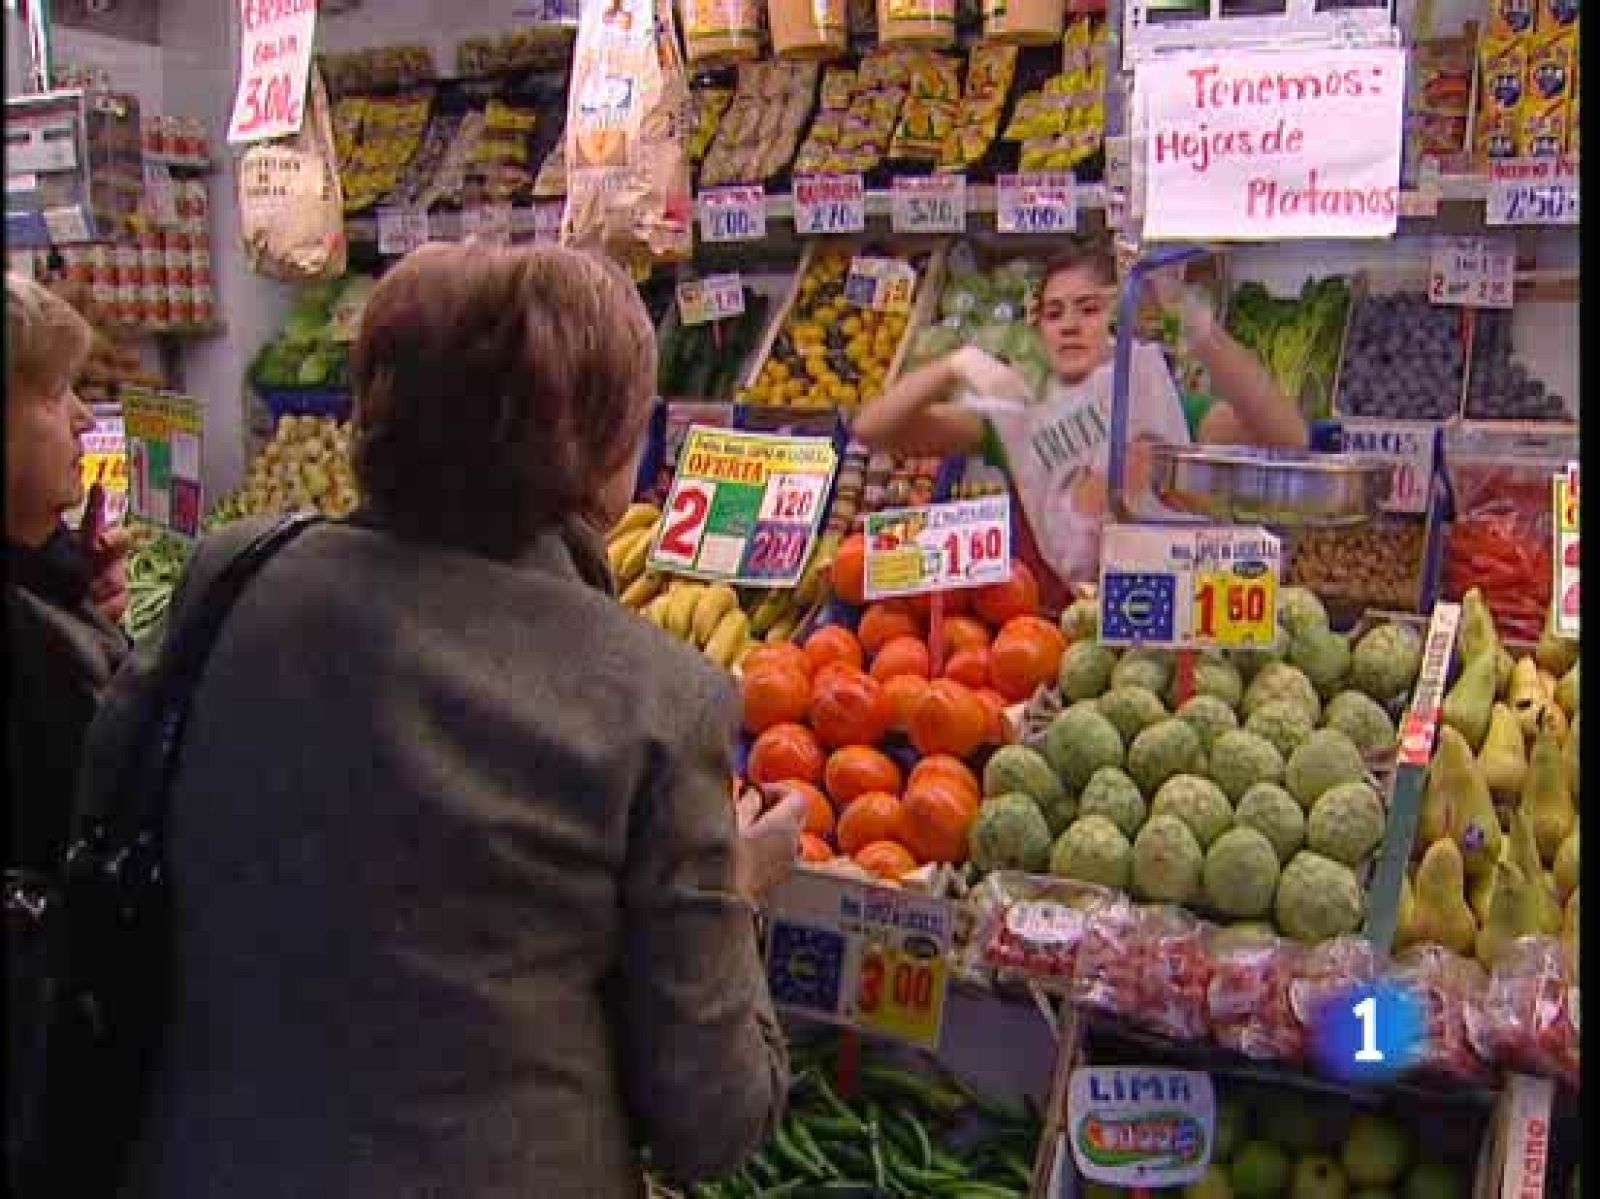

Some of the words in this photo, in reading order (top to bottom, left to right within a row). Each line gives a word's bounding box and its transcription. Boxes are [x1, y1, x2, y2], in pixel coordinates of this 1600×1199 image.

[1260, 118, 1304, 155] de
[1247, 168, 1397, 218] Platanos
[660, 487, 708, 557] 2
